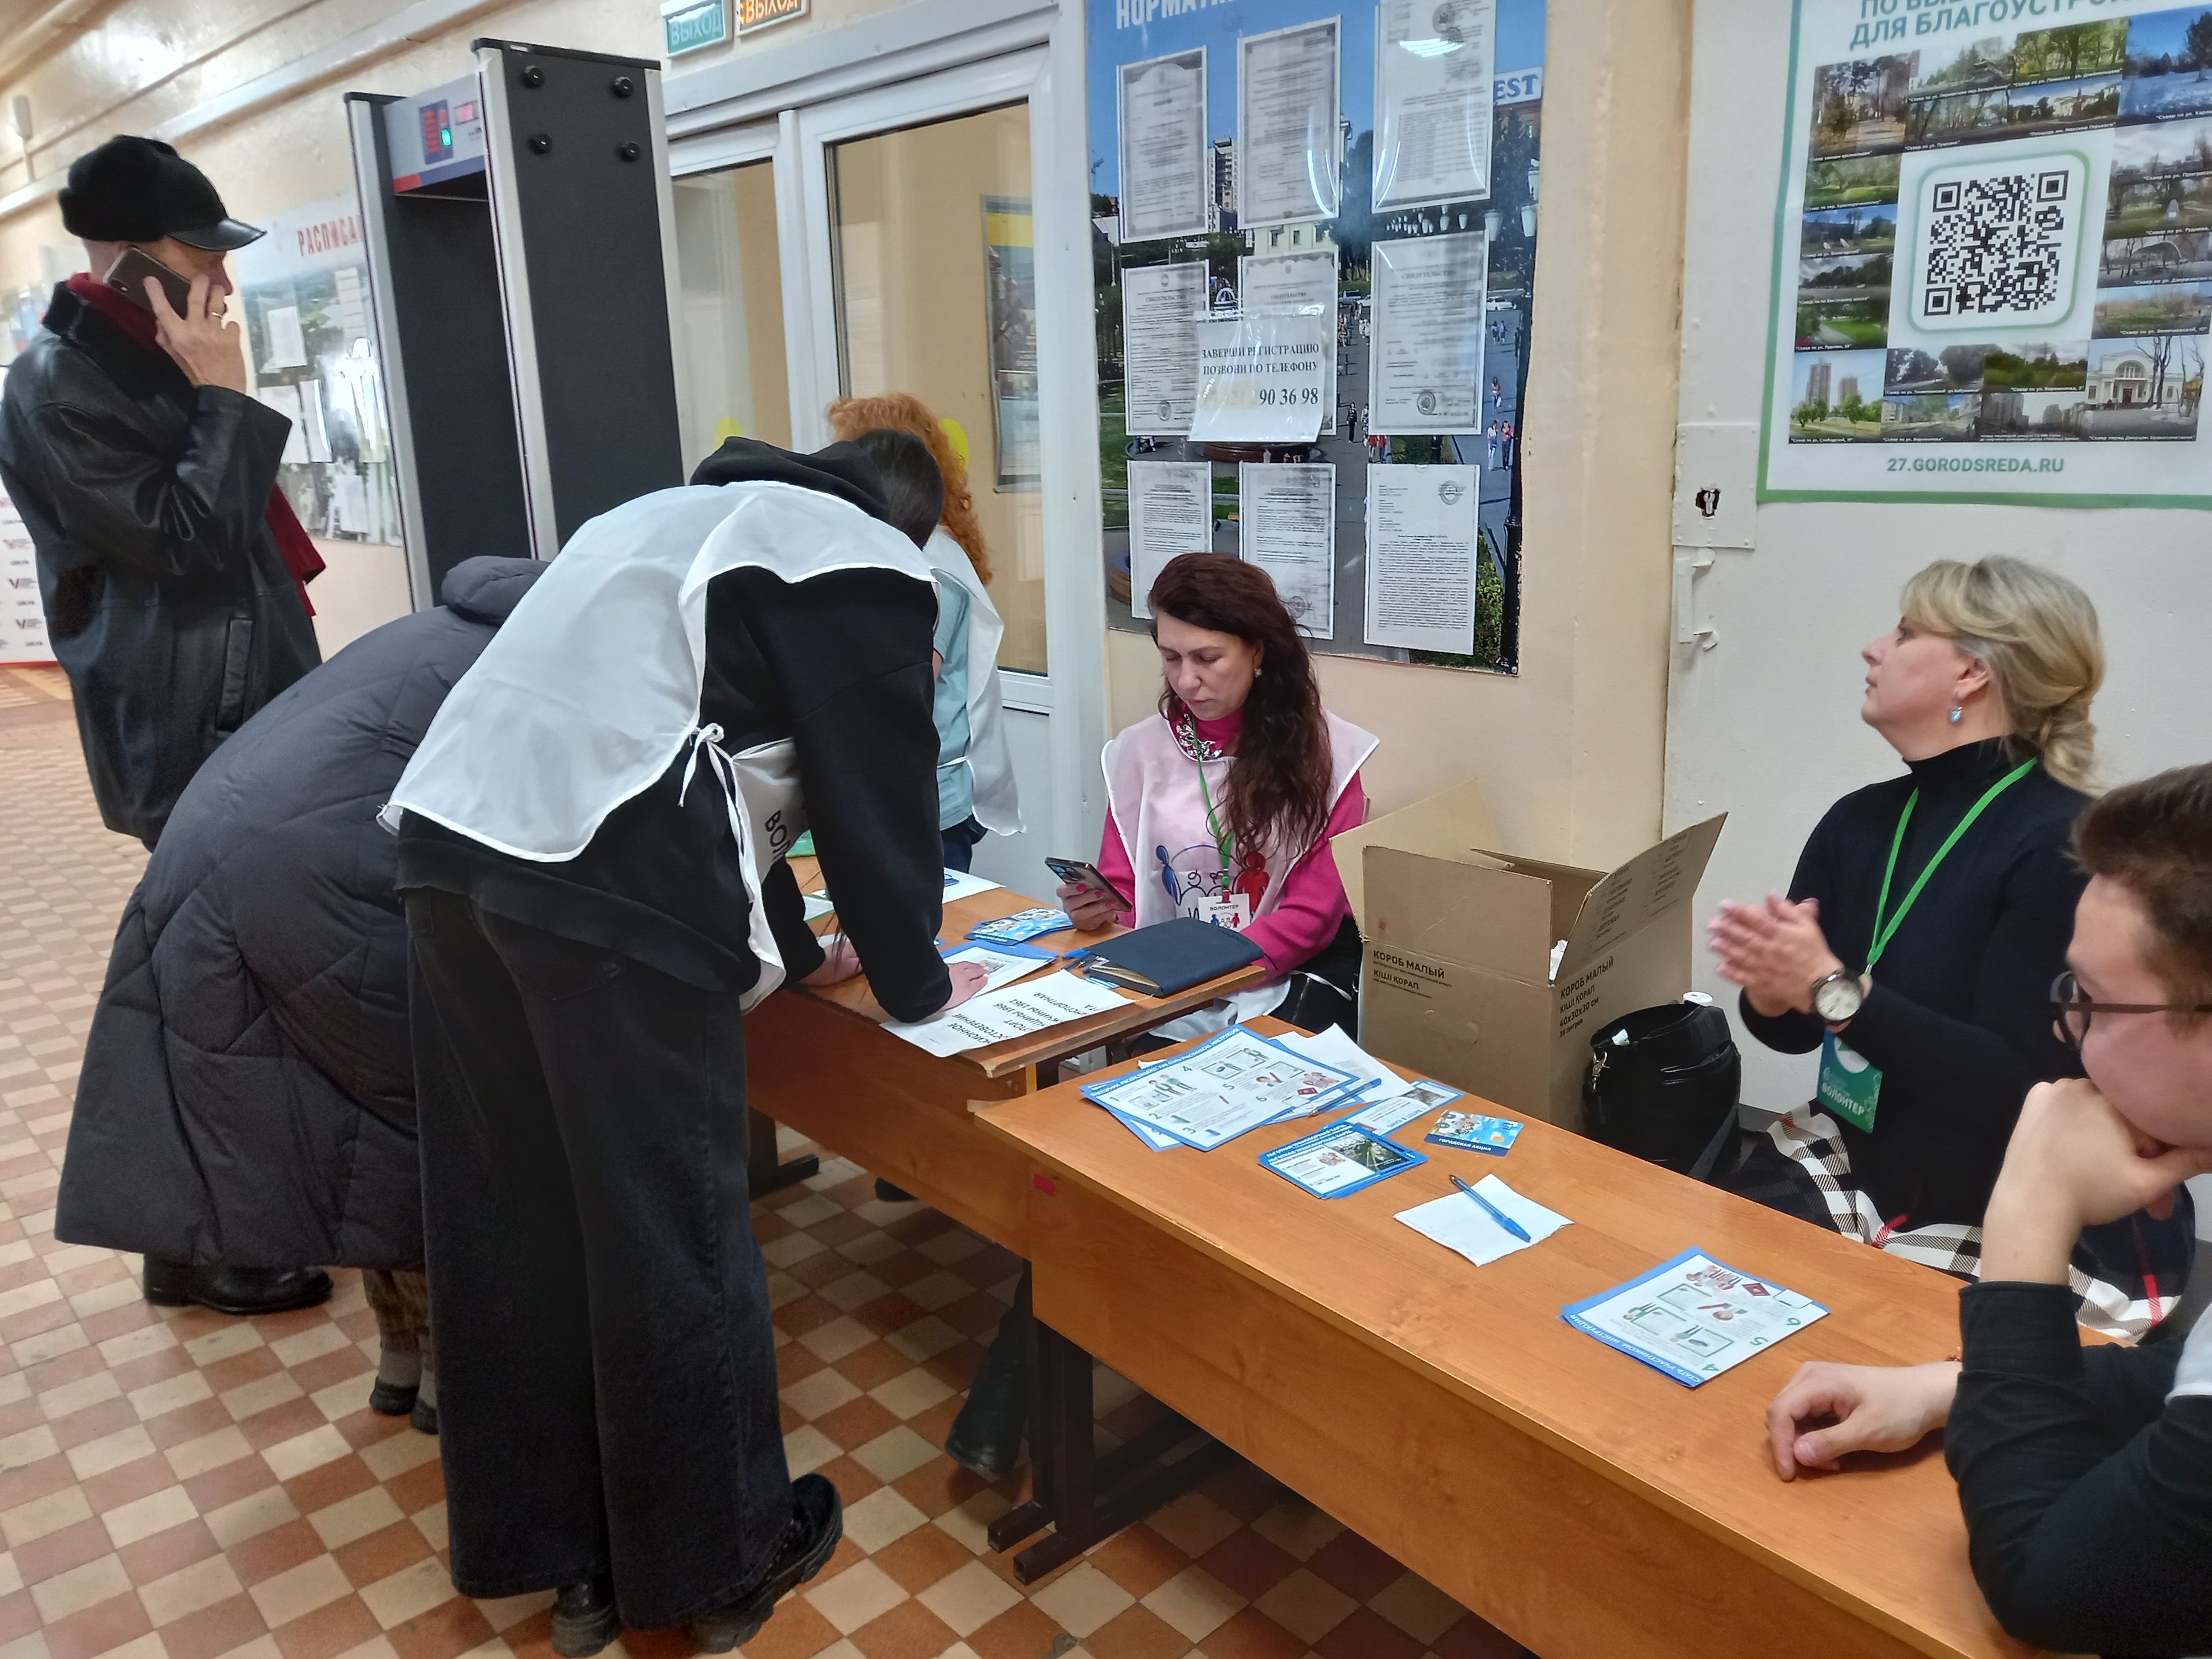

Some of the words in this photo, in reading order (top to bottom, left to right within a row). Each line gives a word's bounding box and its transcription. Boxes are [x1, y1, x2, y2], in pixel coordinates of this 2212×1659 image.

[671, 9, 722, 45] ВЫХОД
[1850, 17, 1907, 51] ДЛЯ
[1494, 75, 1537, 99] EST
[1202, 347, 1245, 358] ЗАВЕРШИ
[1248, 343, 1319, 357] РЕГИСТРАЦИЮ
[1203, 364, 1246, 375] ПОЗВОНИ
[1266, 361, 1318, 373] ТЕЛЕФОНУ
[1259, 388, 1276, 405] 90
[1280, 388, 1297, 405] 36
[1302, 387, 1318, 405] 98
[1887, 457, 2065, 472] 27.GORODSREDA.RU
[1373, 950, 1404, 967] КОРОБ
[1406, 959, 1445, 979] МАЛЫЙ
[1561, 977, 1585, 1000] КОРОБ
[1586, 956, 1614, 983] МАЛЫЙ
[1821, 1082, 1865, 1116] ВОЛОНТЕР
[1438, 1138, 1471, 1147] ГОРОДСКАЯ
[1570, 1313, 1621, 1344] ИНСТРУКЦИЯ
[1677, 1368, 1700, 1383] СТАТЬ
